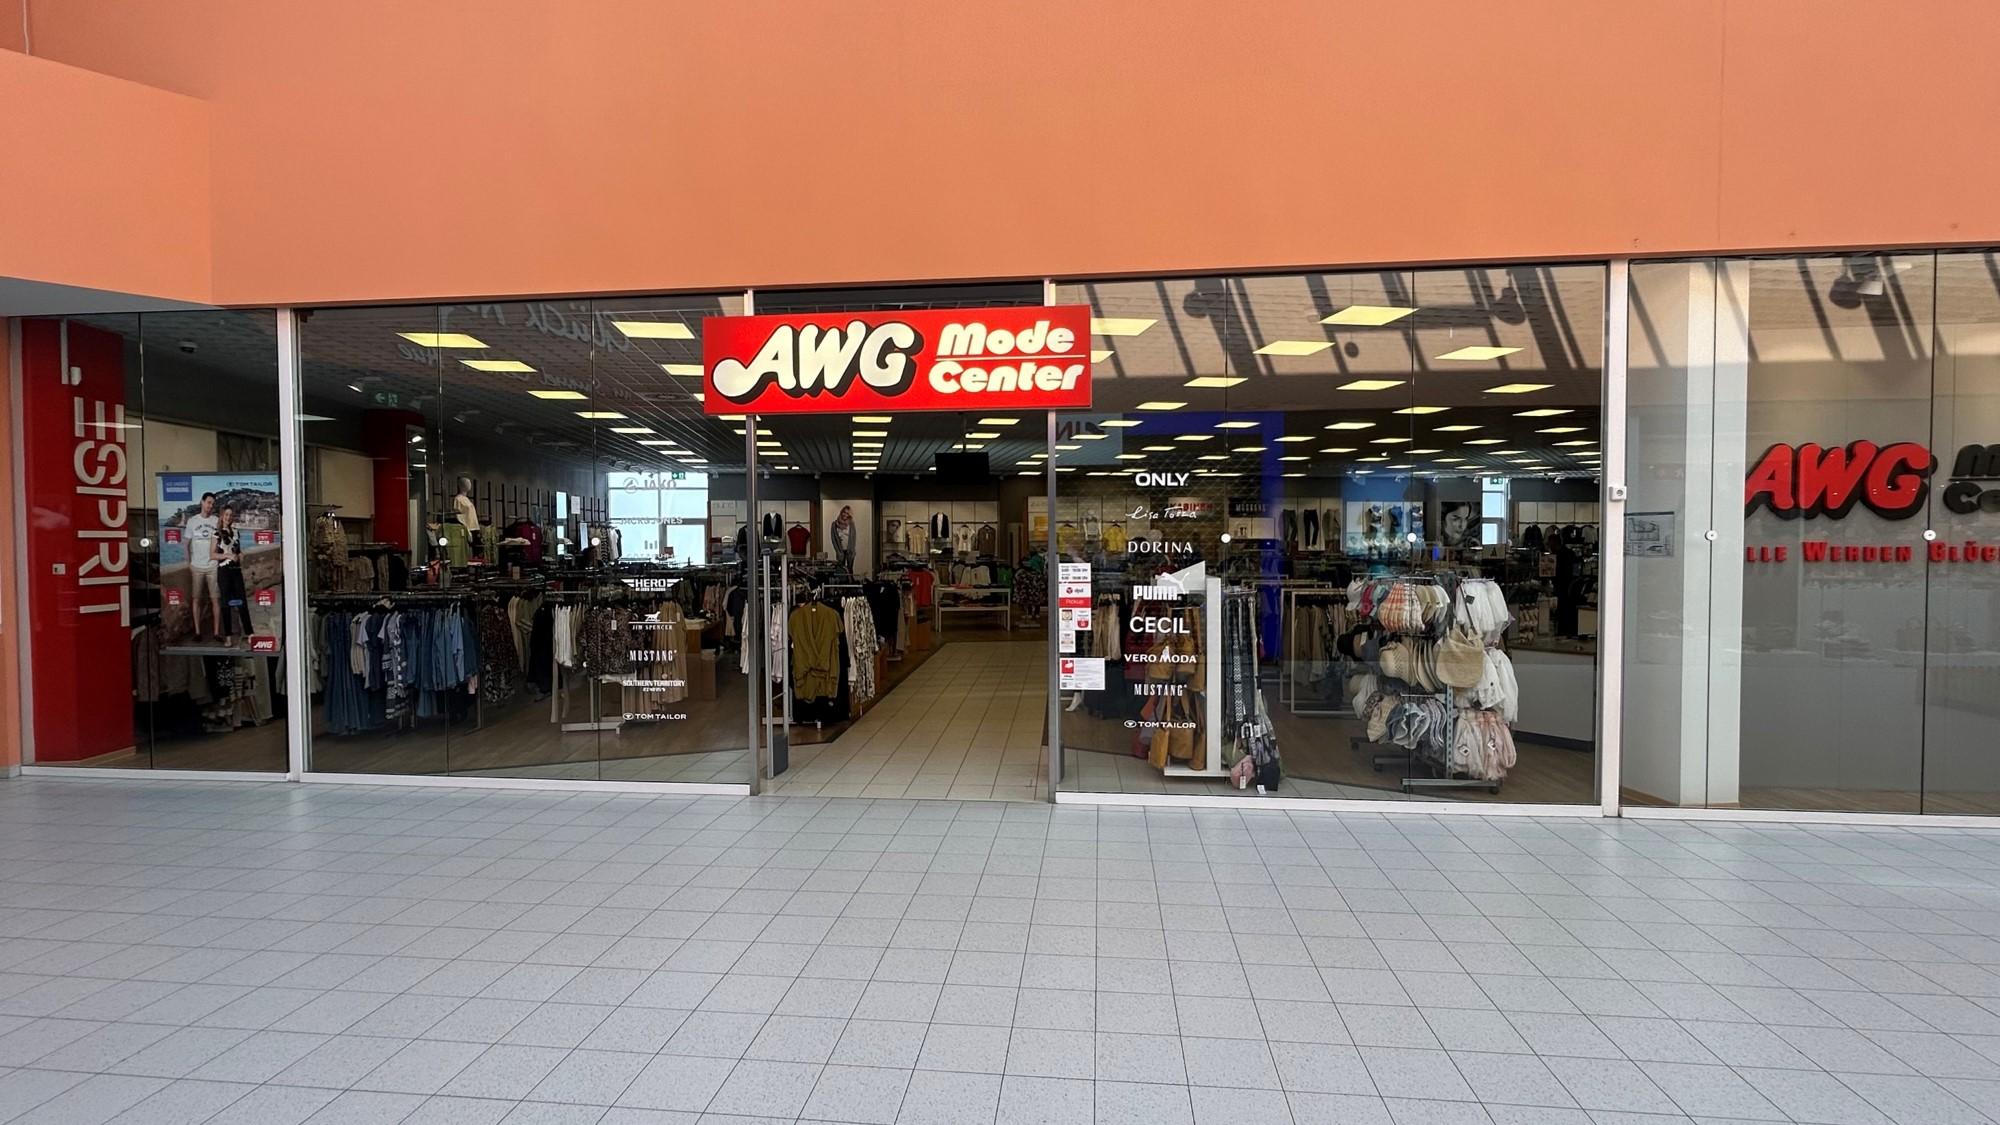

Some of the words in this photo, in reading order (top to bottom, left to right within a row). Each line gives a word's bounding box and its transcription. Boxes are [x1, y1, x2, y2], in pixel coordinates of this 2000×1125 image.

[936, 320, 1075, 356] Mode
[712, 320, 923, 404] AWG
[928, 360, 1085, 394] Center
[1135, 472, 1190, 487] ONLY
[1745, 439, 1938, 521] AWG
[74, 396, 130, 627] ESPRIT
[1127, 541, 1193, 554] DORINA
[1928, 540, 2000, 564] GLÜC
[635, 578, 666, 588] HERO
[1133, 585, 1178, 600] PUMA
[1129, 616, 1190, 634] CECIL
[253, 641, 273, 649] AWG
[629, 649, 673, 662] MUSTANG
[1124, 653, 1157, 663] VERO
[1159, 653, 1197, 664] MODA
[1133, 684, 1183, 697] MUSTANG
[1138, 721, 1163, 729] TOM
[1162, 721, 1197, 729] TAILOR
